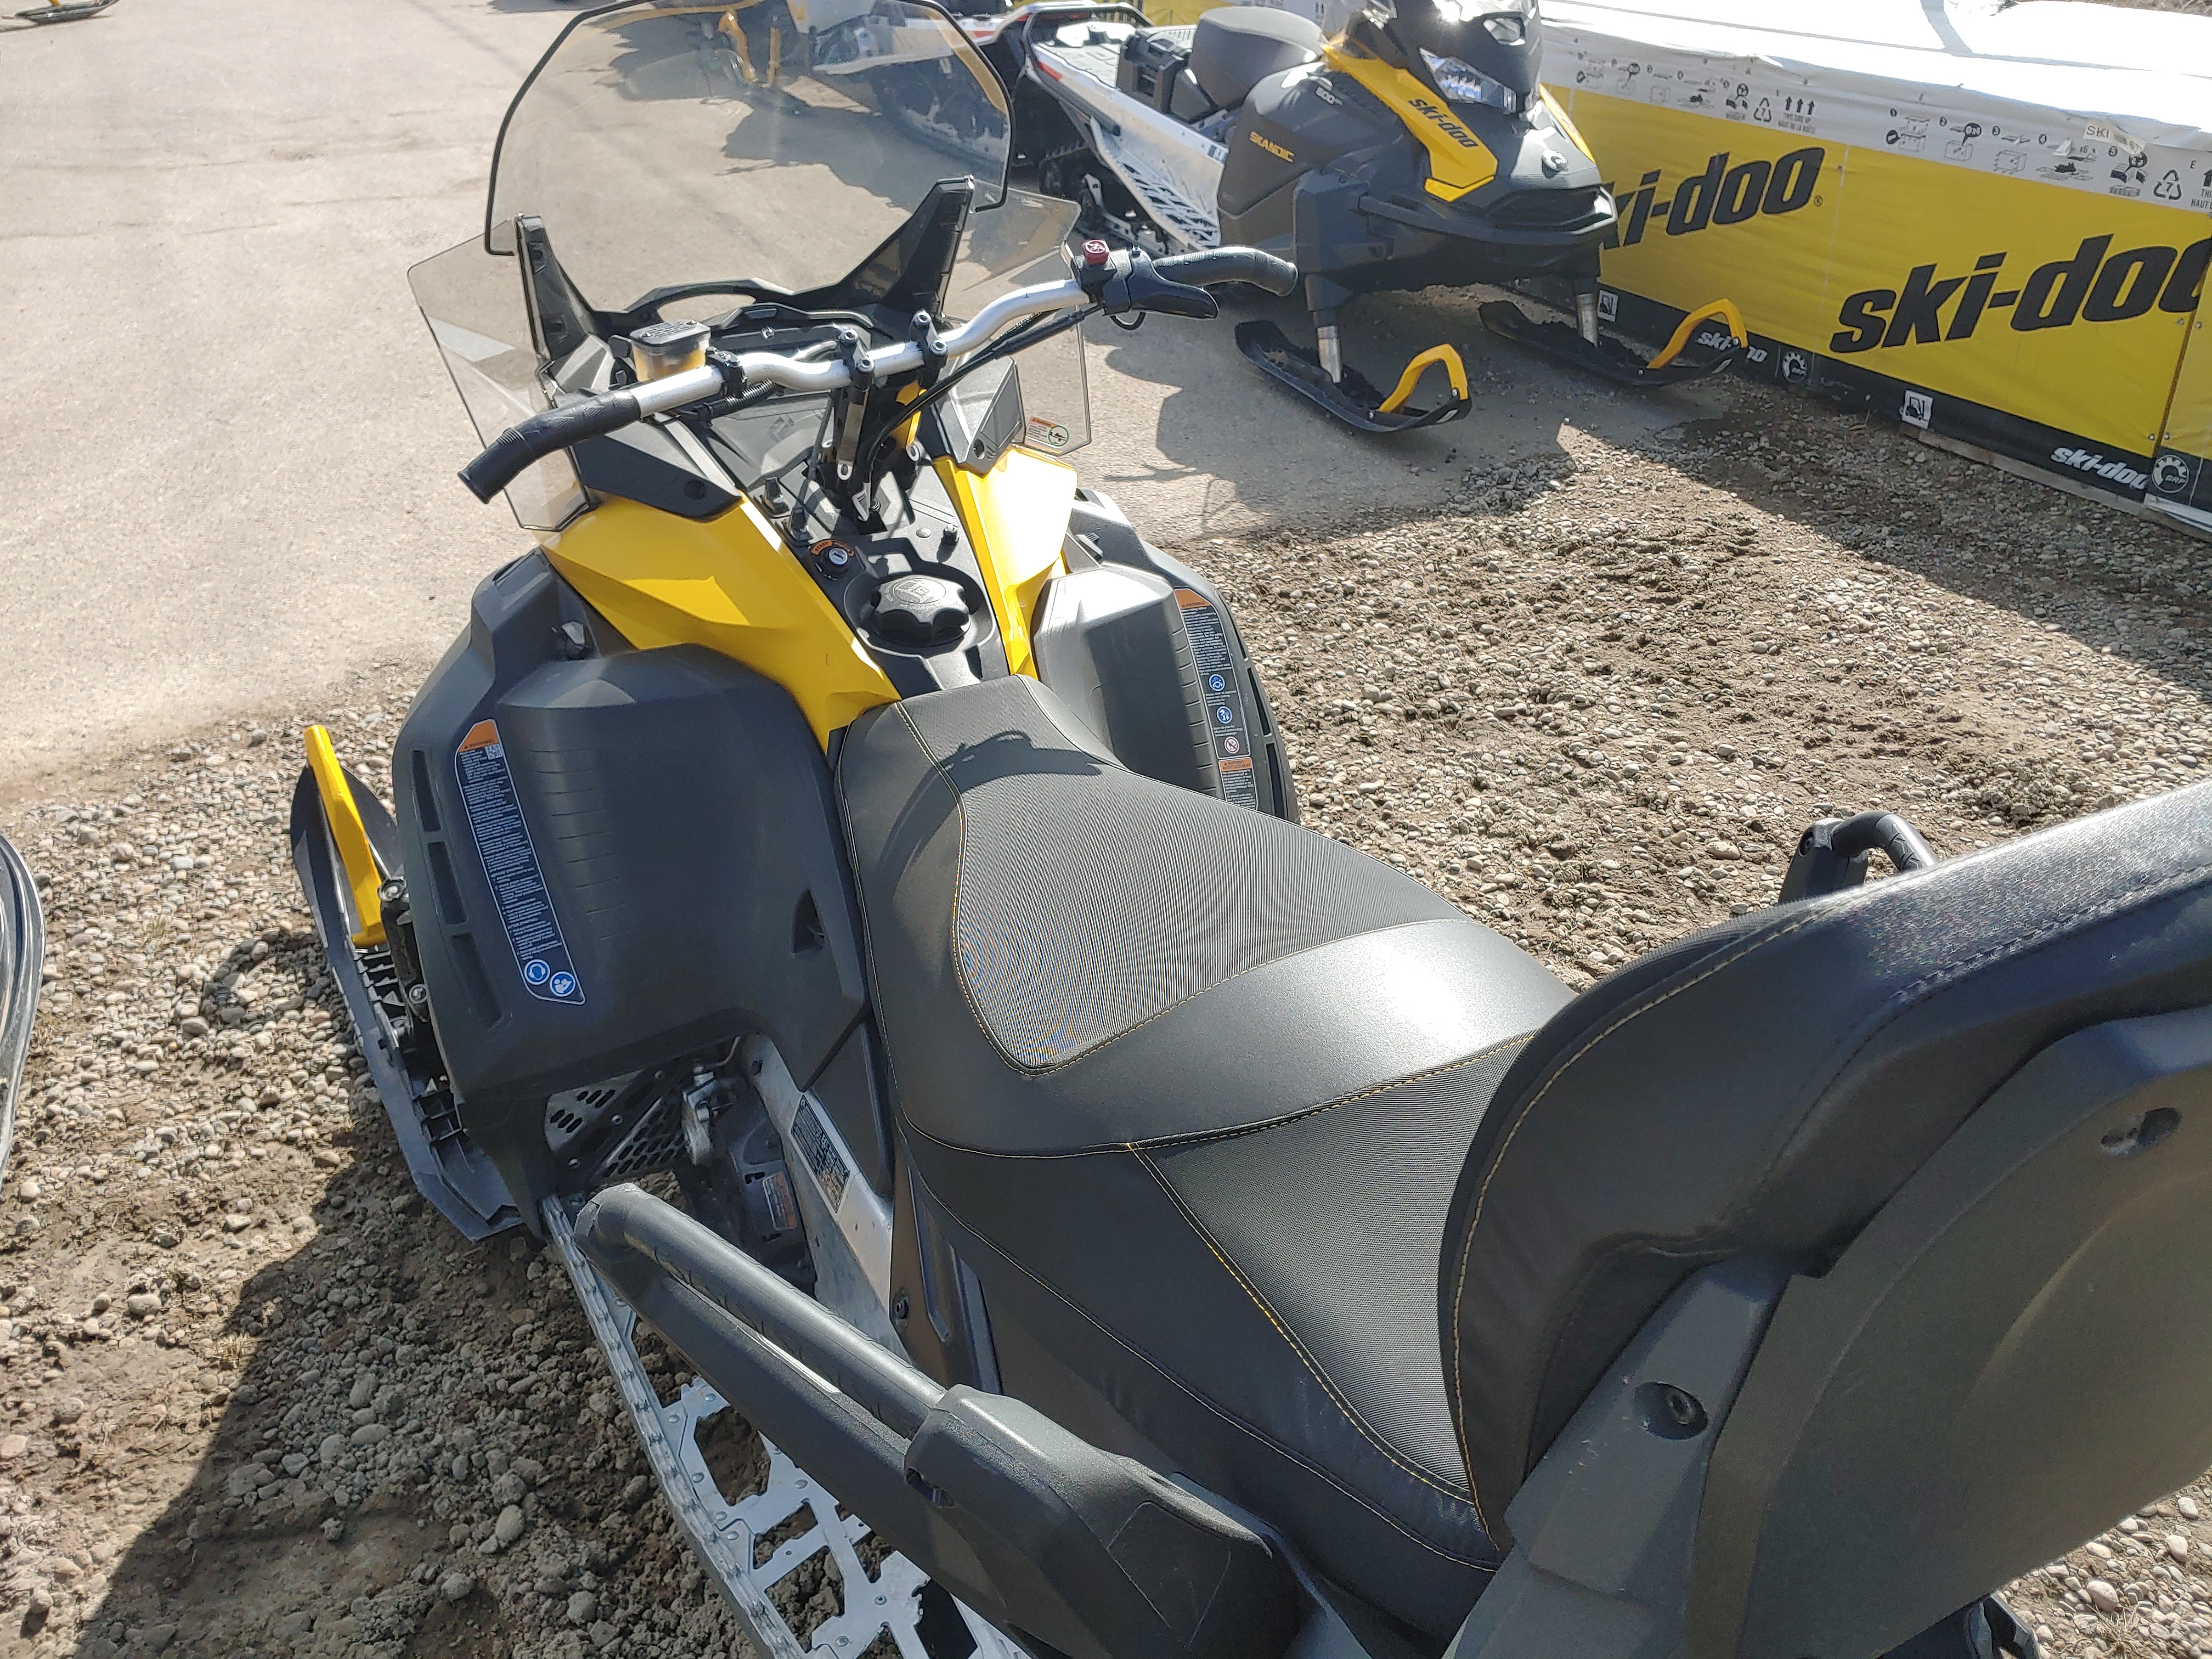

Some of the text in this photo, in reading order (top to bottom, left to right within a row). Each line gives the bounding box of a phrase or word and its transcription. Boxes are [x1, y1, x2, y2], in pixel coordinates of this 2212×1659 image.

[1408, 98, 1478, 147] ski-doo
[2086, 125, 2109, 138] SKI
[1602, 147, 1825, 250] ki-doo
[2201, 189, 2212, 198] THI
[2191, 199, 2208, 210] HAUT
